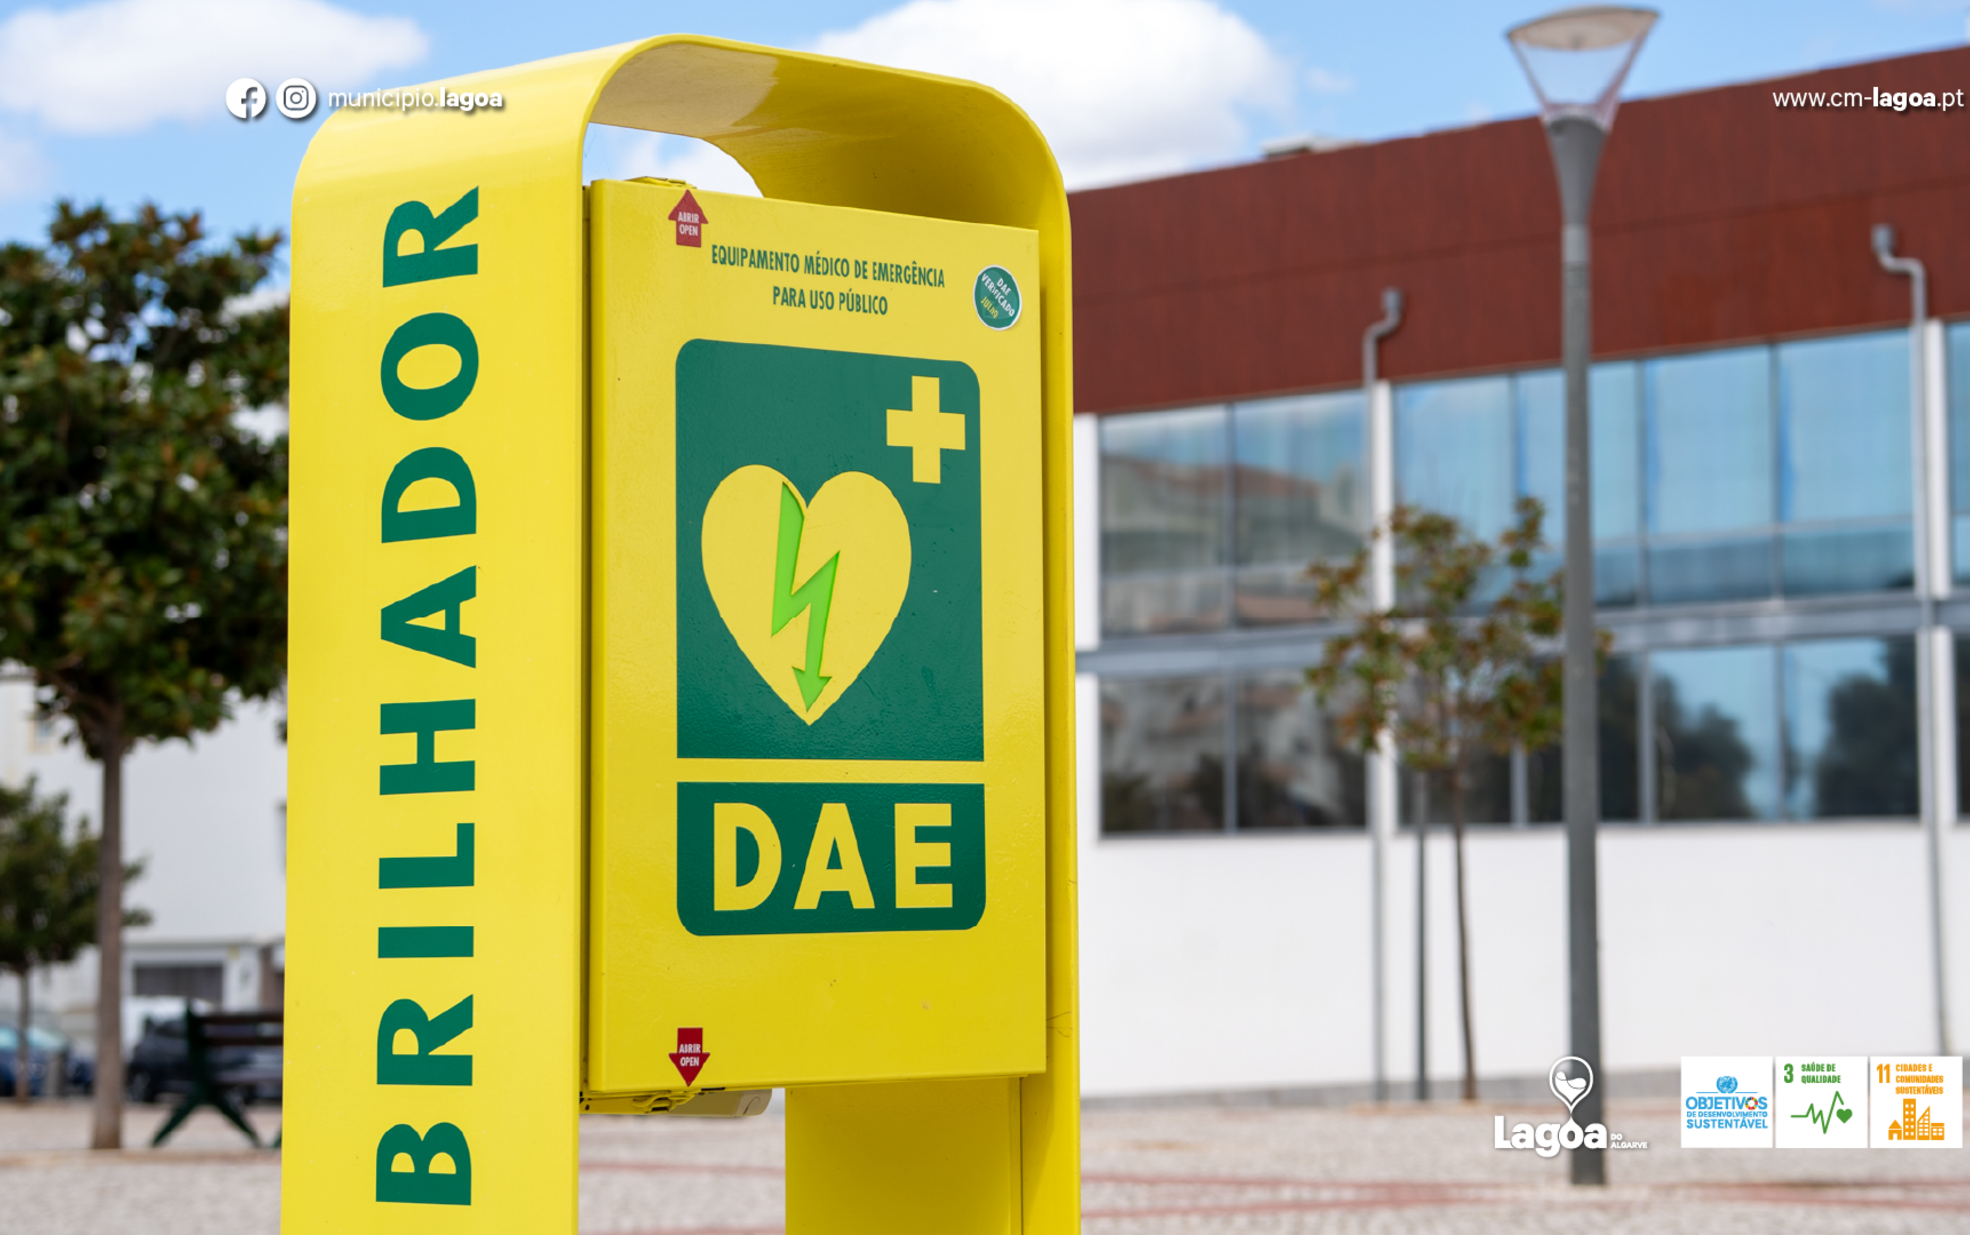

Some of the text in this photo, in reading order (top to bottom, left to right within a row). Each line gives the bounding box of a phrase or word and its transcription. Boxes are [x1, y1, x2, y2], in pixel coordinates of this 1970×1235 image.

[678, 211, 700, 224] ABRIR
[679, 223, 699, 236] OPEN
[711, 244, 946, 288] EQUIPAMENTO MÉDICO DE EMERGÊNCIA
[981, 273, 1015, 317] VERIFICADO
[996, 277, 1012, 296] DAE
[772, 285, 889, 316] PARA USO PÚBLICO
[376, 186, 479, 1206] BRILHADOR
[713, 802, 953, 911] DAE
[679, 1043, 701, 1054] ABRIR
[680, 1056, 700, 1067] OPEN
